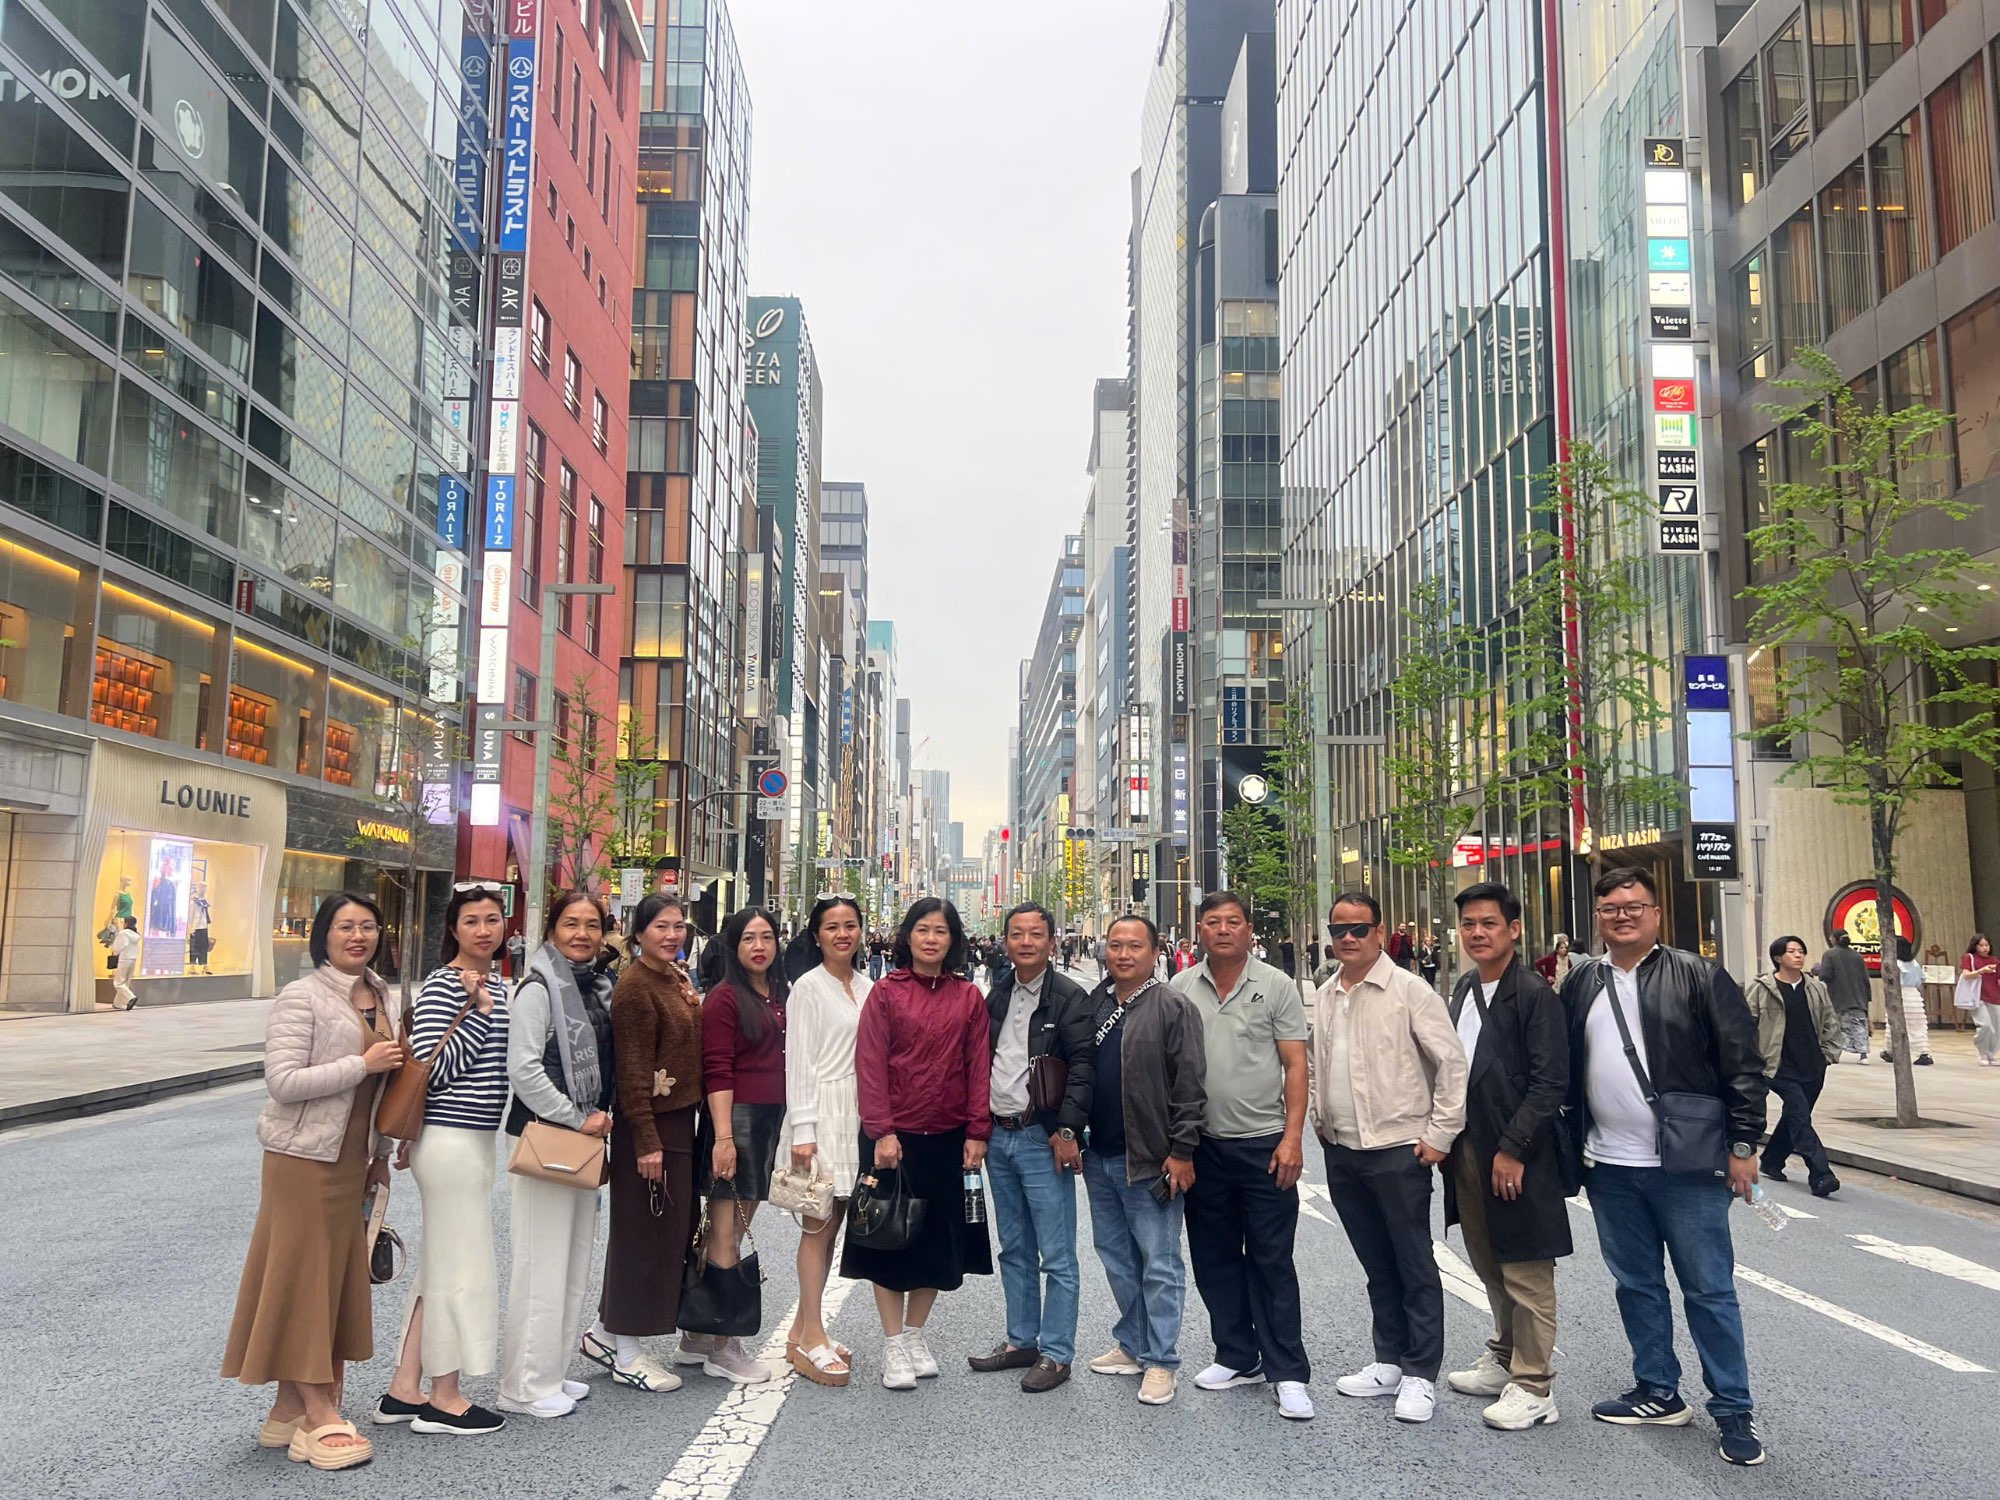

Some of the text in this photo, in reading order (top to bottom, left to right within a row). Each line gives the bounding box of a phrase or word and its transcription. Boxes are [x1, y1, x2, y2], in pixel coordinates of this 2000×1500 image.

[515, 1, 534, 34] ビル
[505, 84, 530, 235] スペーストラスト
[501, 286, 519, 310] AK
[1653, 315, 1688, 325] Valette
[1660, 463, 1695, 474] RASIN
[494, 480, 507, 545] TORAIZ
[1662, 534, 1698, 544] RASIN
[748, 598, 760, 640] OTSUKA
[746, 653, 758, 692] YAMADA
[1176, 643, 1185, 695] MONTBLANC
[483, 711, 496, 761] SUNA
[161, 780, 251, 819] LOUNIE
[1600, 827, 1661, 851] INZA RASIN
[1700, 832, 1727, 841] カフェー
